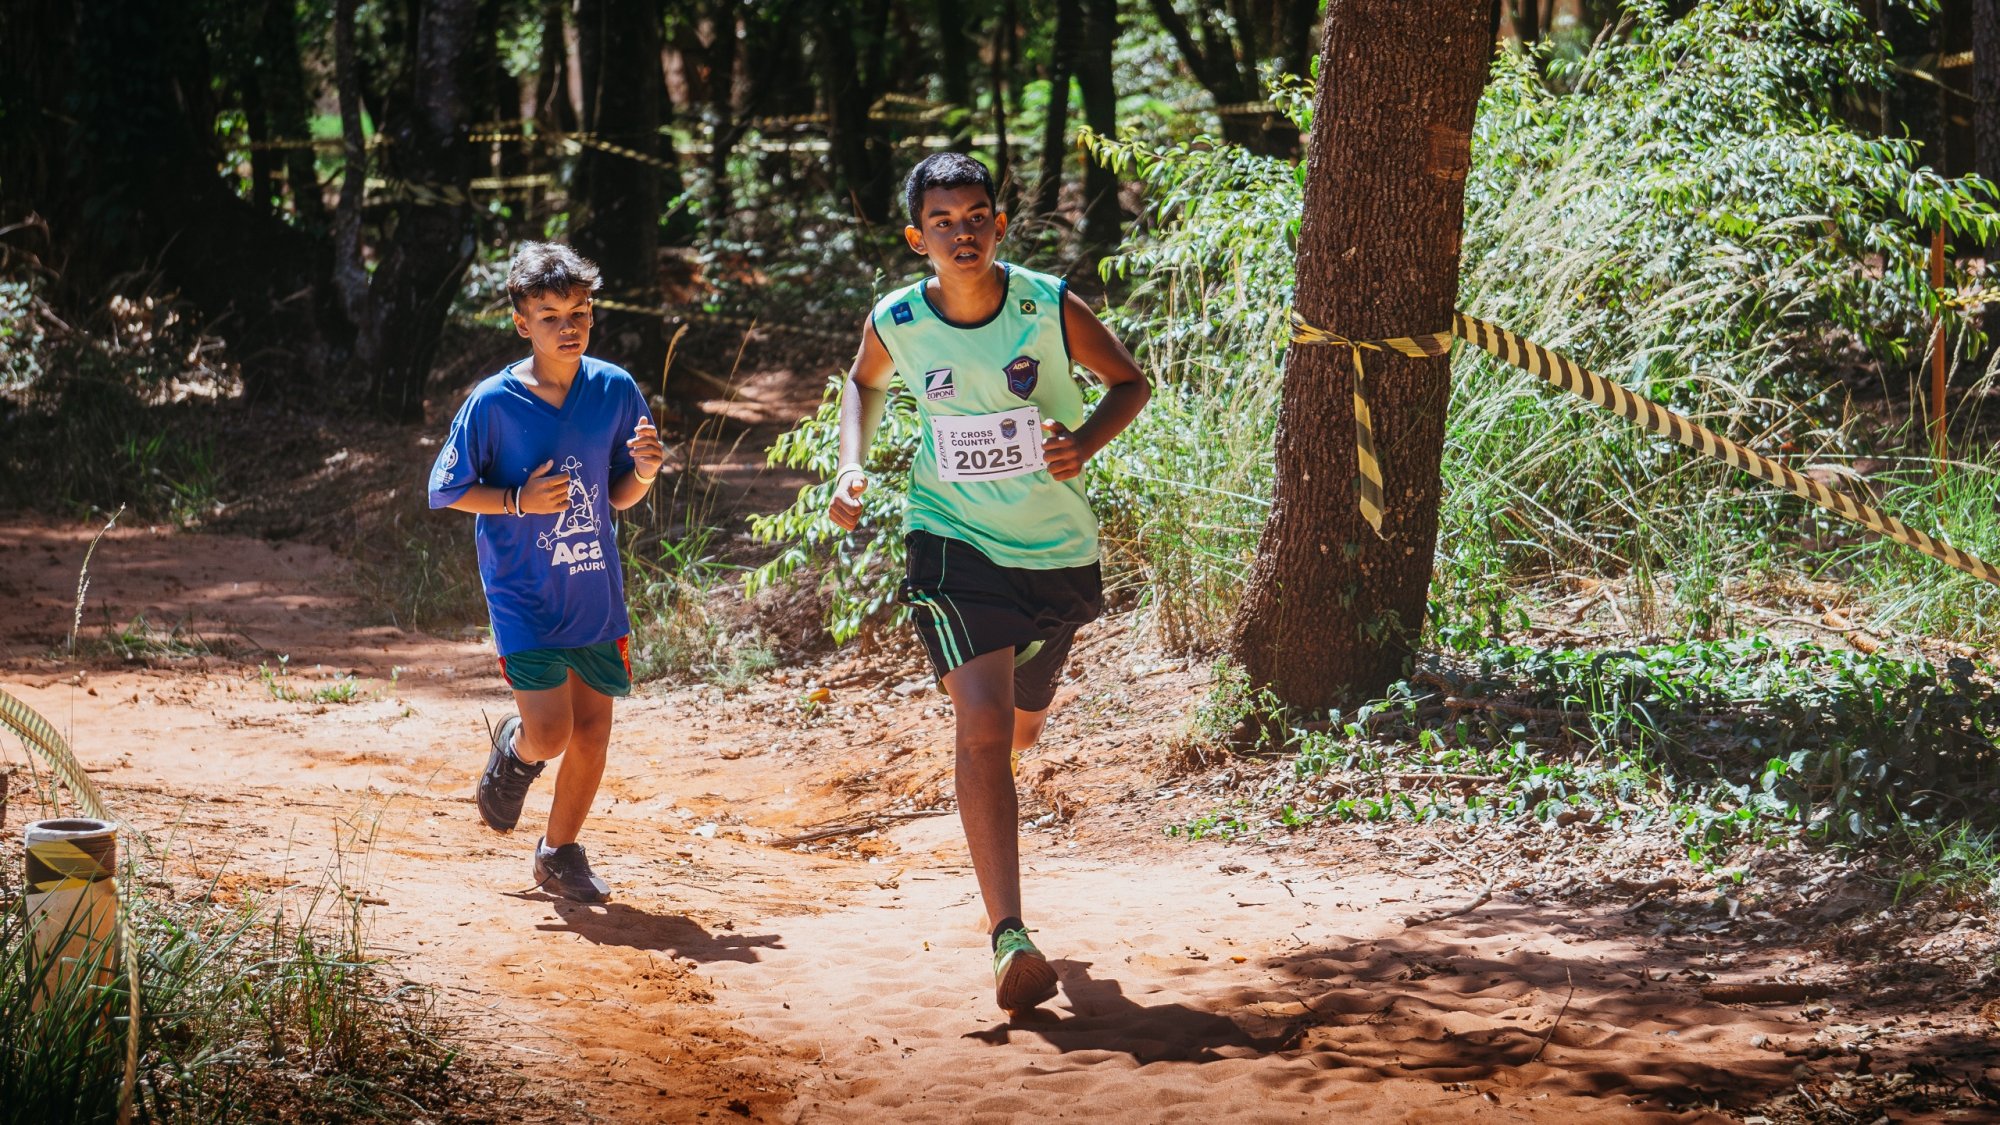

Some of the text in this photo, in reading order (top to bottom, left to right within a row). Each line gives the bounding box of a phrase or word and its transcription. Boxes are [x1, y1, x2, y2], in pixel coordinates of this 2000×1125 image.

[927, 389, 956, 400] ZOPONE
[961, 430, 993, 439] CROSS
[951, 437, 996, 447] COUNTRY
[954, 444, 1023, 470] 2025
[552, 540, 603, 566] Aca
[569, 560, 606, 576] BAURU
